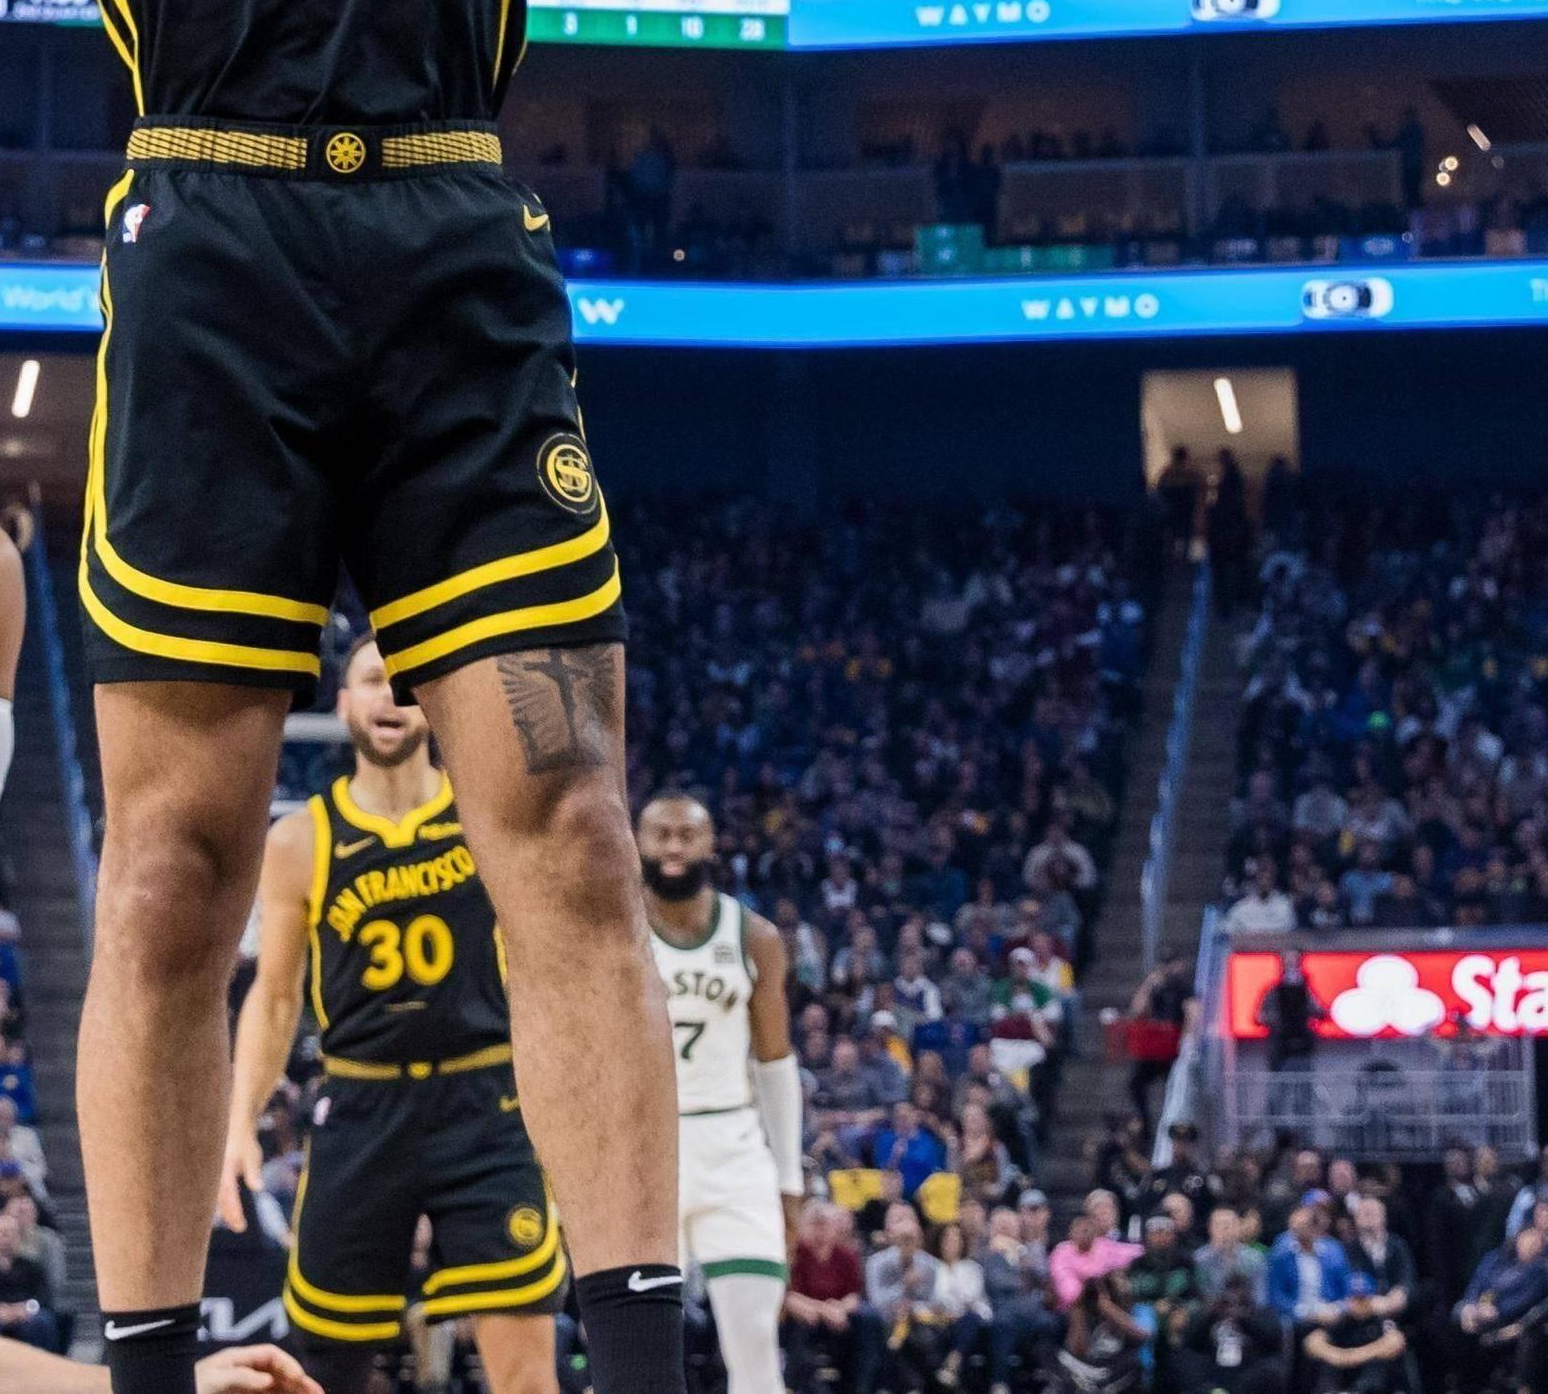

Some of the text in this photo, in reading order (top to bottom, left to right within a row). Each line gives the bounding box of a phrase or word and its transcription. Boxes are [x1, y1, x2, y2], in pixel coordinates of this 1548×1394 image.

[563, 10, 578, 36] 3
[626, 14, 638, 36] 1
[1020, 293, 1160, 320] WAYMO
[327, 845, 477, 943] SAN FRANCISCO
[358, 913, 455, 992] 30
[673, 970, 739, 1015] STON
[673, 1020, 707, 1062] 7
